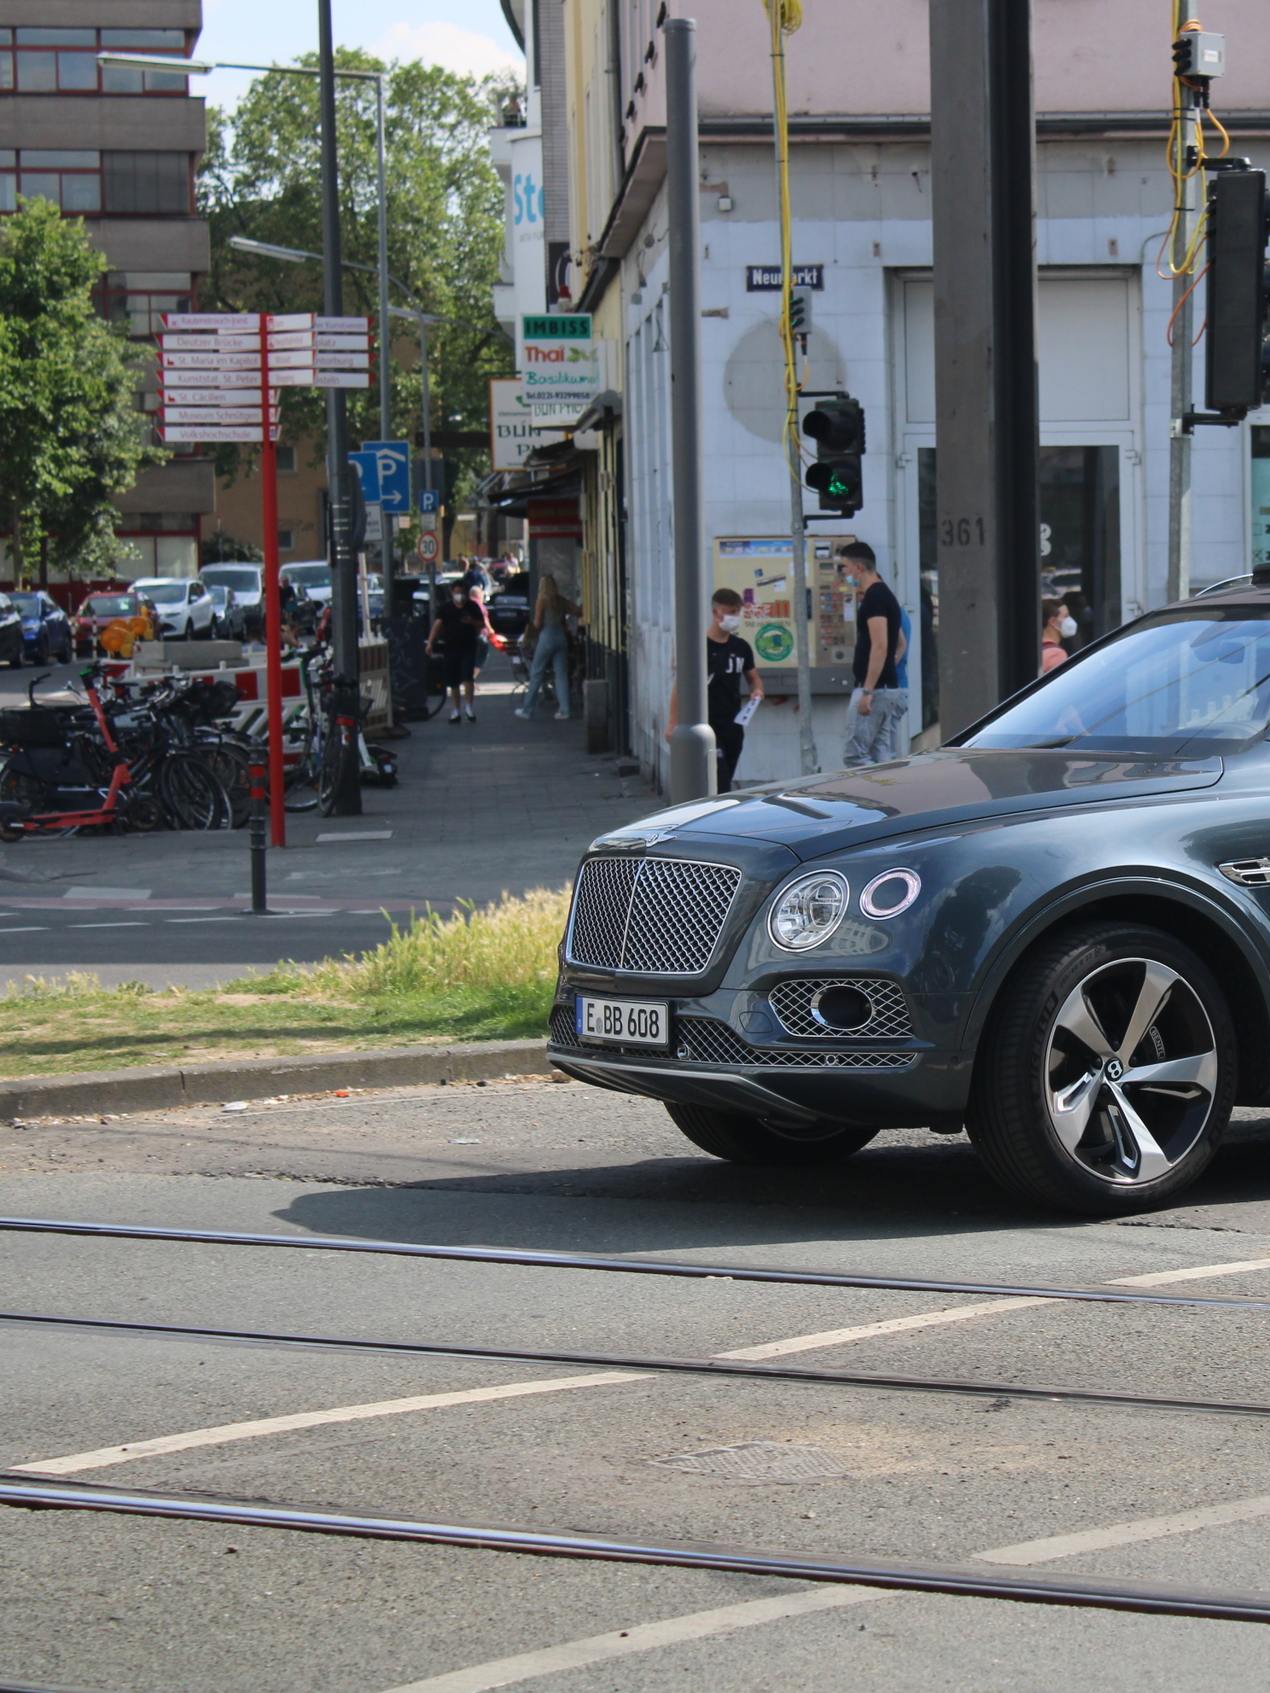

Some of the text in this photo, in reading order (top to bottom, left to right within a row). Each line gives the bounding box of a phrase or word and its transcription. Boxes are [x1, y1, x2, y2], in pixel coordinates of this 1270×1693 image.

[526, 320, 589, 335] IMBISS
[177, 336, 243, 347] Deutzer Brücke
[314, 338, 336, 347] platz
[178, 355, 258, 368] St. Maria im Kapitol
[314, 356, 354, 369] ntorburg
[223, 374, 233, 383] St.
[235, 374, 258, 383] Peter
[179, 389, 226, 399] St. Cäcilien
[179, 410, 259, 422] Museum Schnütgen
[180, 429, 252, 439] Volkshochschule
[941, 517, 985, 547] 361
[421, 540, 435, 554] 30
[587, 1003, 660, 1039] E BB 608
[1151, 1027, 1166, 1060] BENTL
